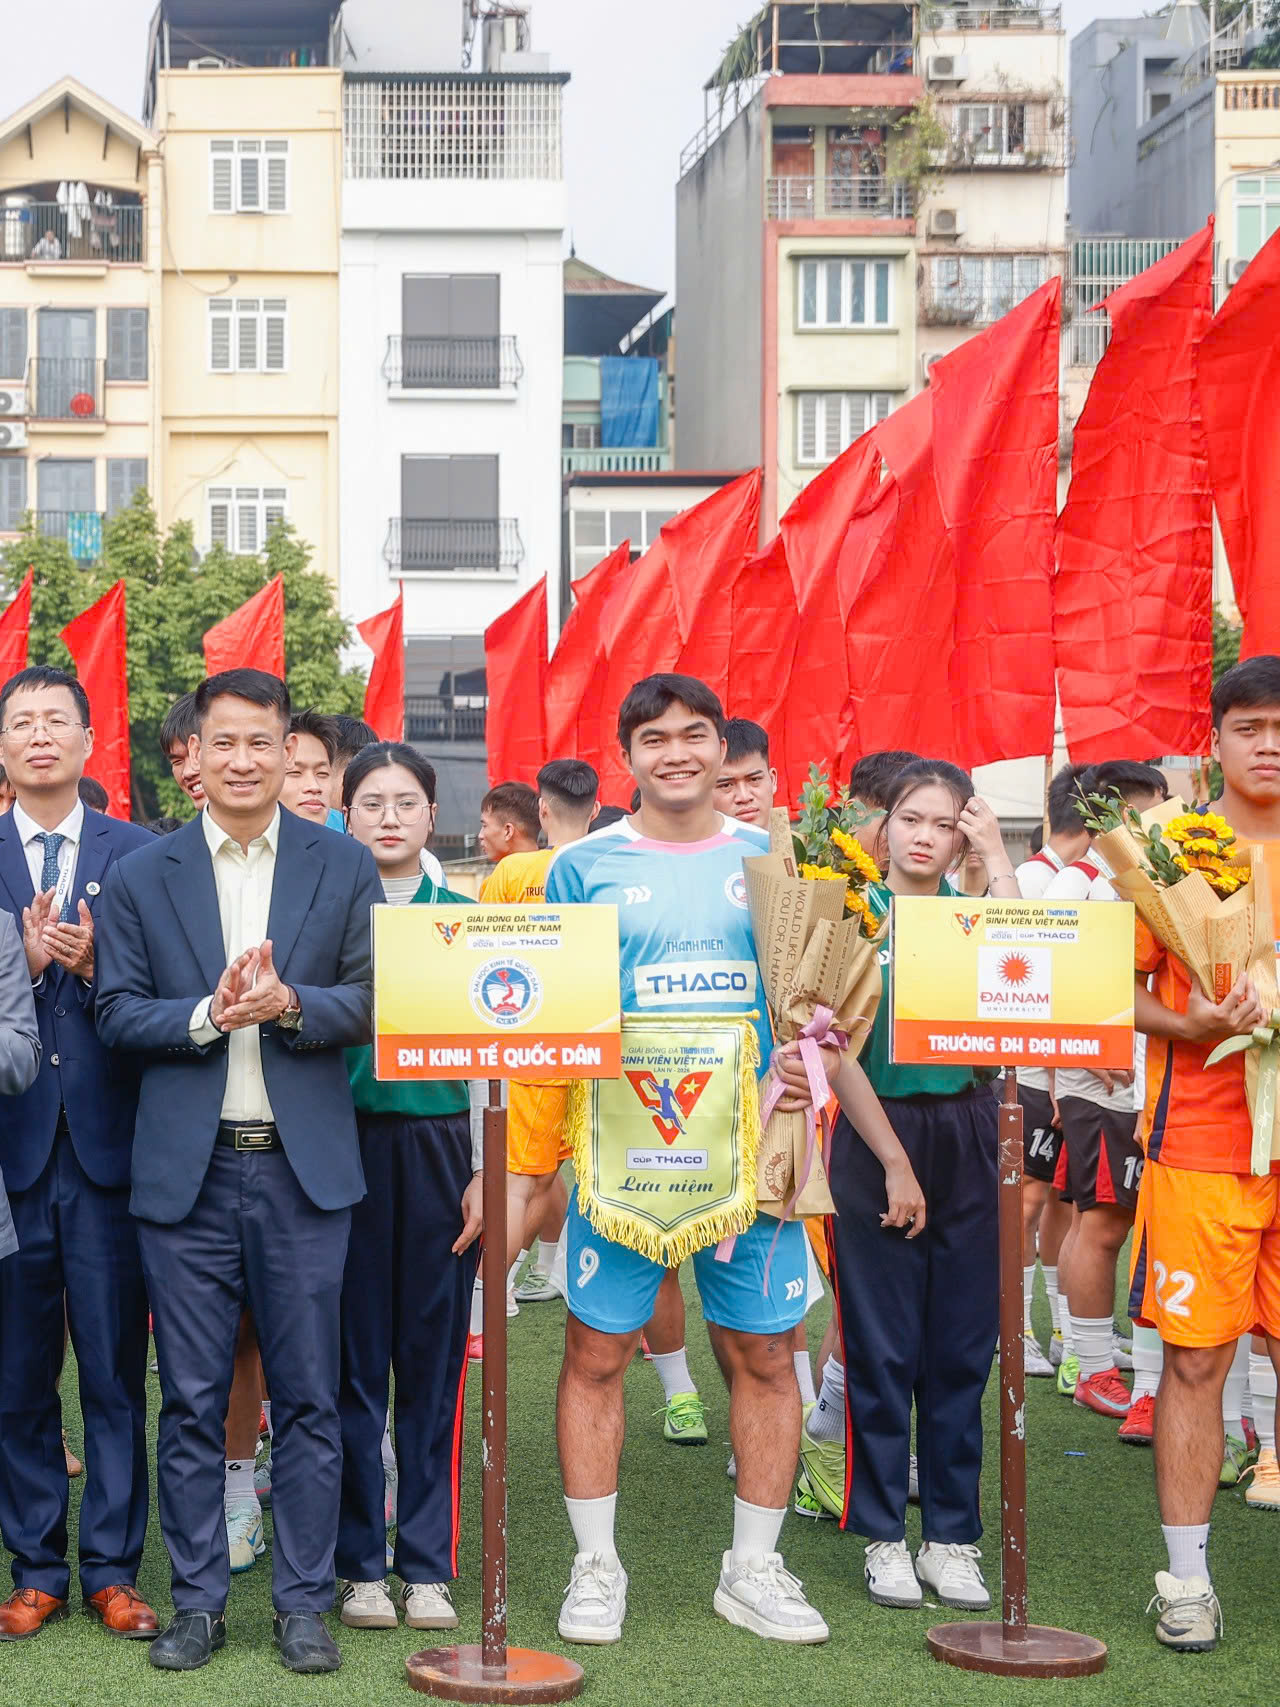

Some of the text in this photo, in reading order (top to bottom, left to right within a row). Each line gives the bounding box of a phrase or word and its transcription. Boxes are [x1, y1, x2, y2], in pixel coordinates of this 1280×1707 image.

[779, 889, 792, 917] YOU
[791, 887, 807, 934] WOULD
[492, 924, 514, 932] VIÊN
[517, 924, 536, 933] VIỆT
[775, 917, 788, 942] FOR
[1011, 917, 1032, 925] VIÊN
[1035, 918, 1054, 927] VIỆT
[667, 940, 699, 952] THANH
[773, 946, 781, 955] A
[786, 935, 798, 960] LIKE
[646, 972, 747, 993] THACO
[784, 965, 794, 982] TO
[980, 992, 1049, 1004] ĐẠI NAM
[397, 1041, 601, 1068] ĐH KINH TẾ QUỐC DÂN
[1000, 1037, 1023, 1053] ĐH
[1028, 1038, 1056, 1056] ĐẠI
[1060, 1039, 1099, 1055] NAM
[621, 1056, 644, 1064] SINH
[647, 1055, 671, 1064] VIÊN
[674, 1055, 696, 1067] VIỆT
[1029, 1128, 1055, 1162] 14
[655, 1156, 702, 1164] THACO
[618, 1176, 713, 1195] Lưu niệm
[577, 1247, 600, 1288] 9
[1153, 1260, 1194, 1317] 22
